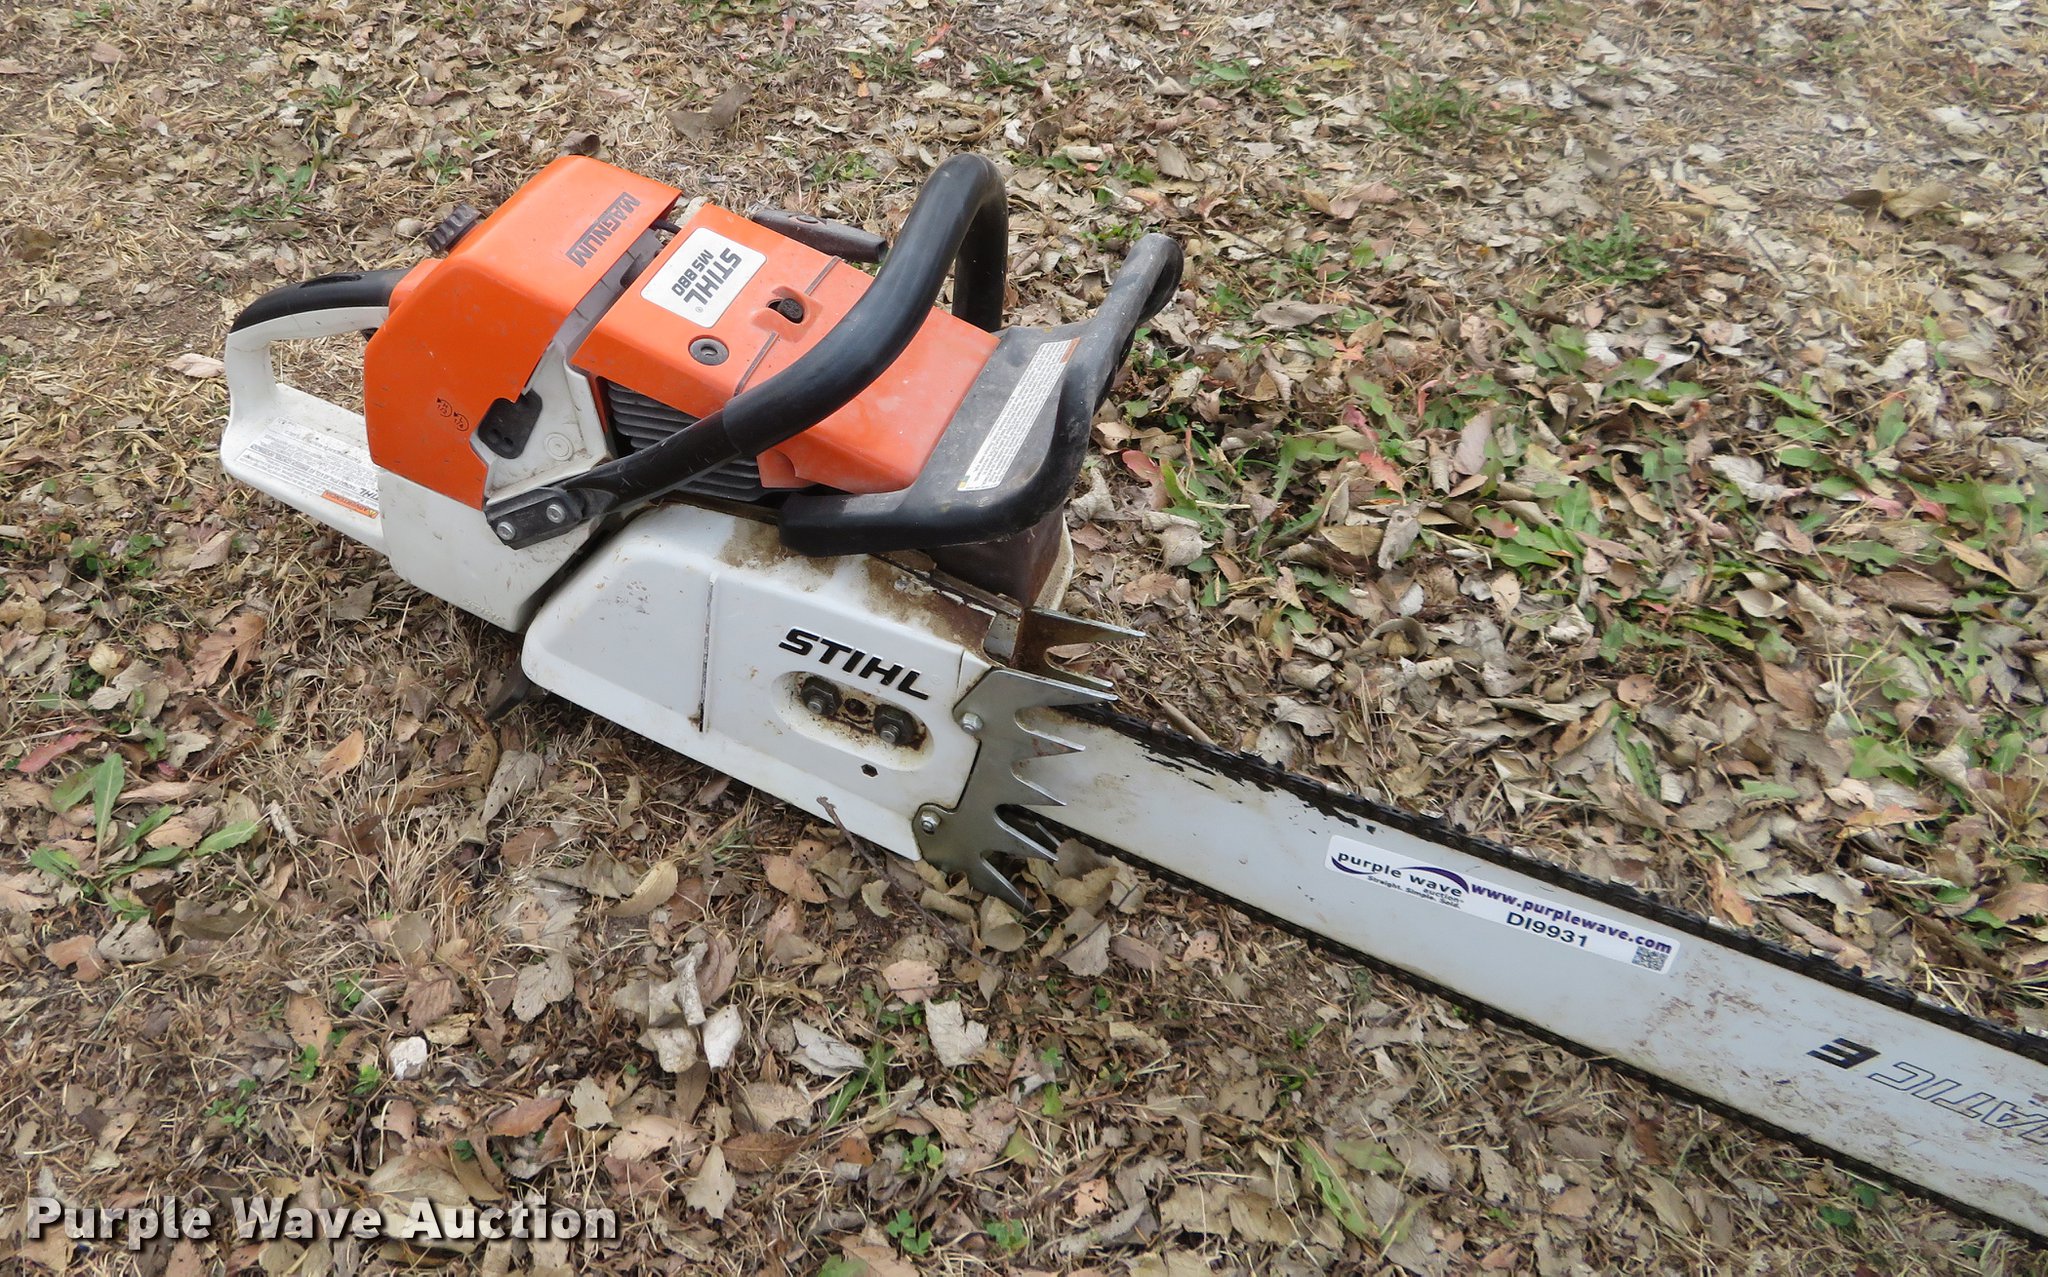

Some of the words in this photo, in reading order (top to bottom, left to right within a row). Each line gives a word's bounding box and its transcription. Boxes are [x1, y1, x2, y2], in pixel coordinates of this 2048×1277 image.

[565, 191, 641, 268] MAGNUM
[671, 268, 698, 296] 880
[683, 248, 742, 305] STIHL
[691, 249, 714, 273] MS
[778, 628, 929, 700] STIHL
[1337, 851, 1402, 879] purple
[1409, 873, 1462, 897] wave
[1471, 882, 1672, 954] www.purplewave.com
[1506, 911, 1588, 948] DI9931
[1806, 1037, 1881, 1069] E
